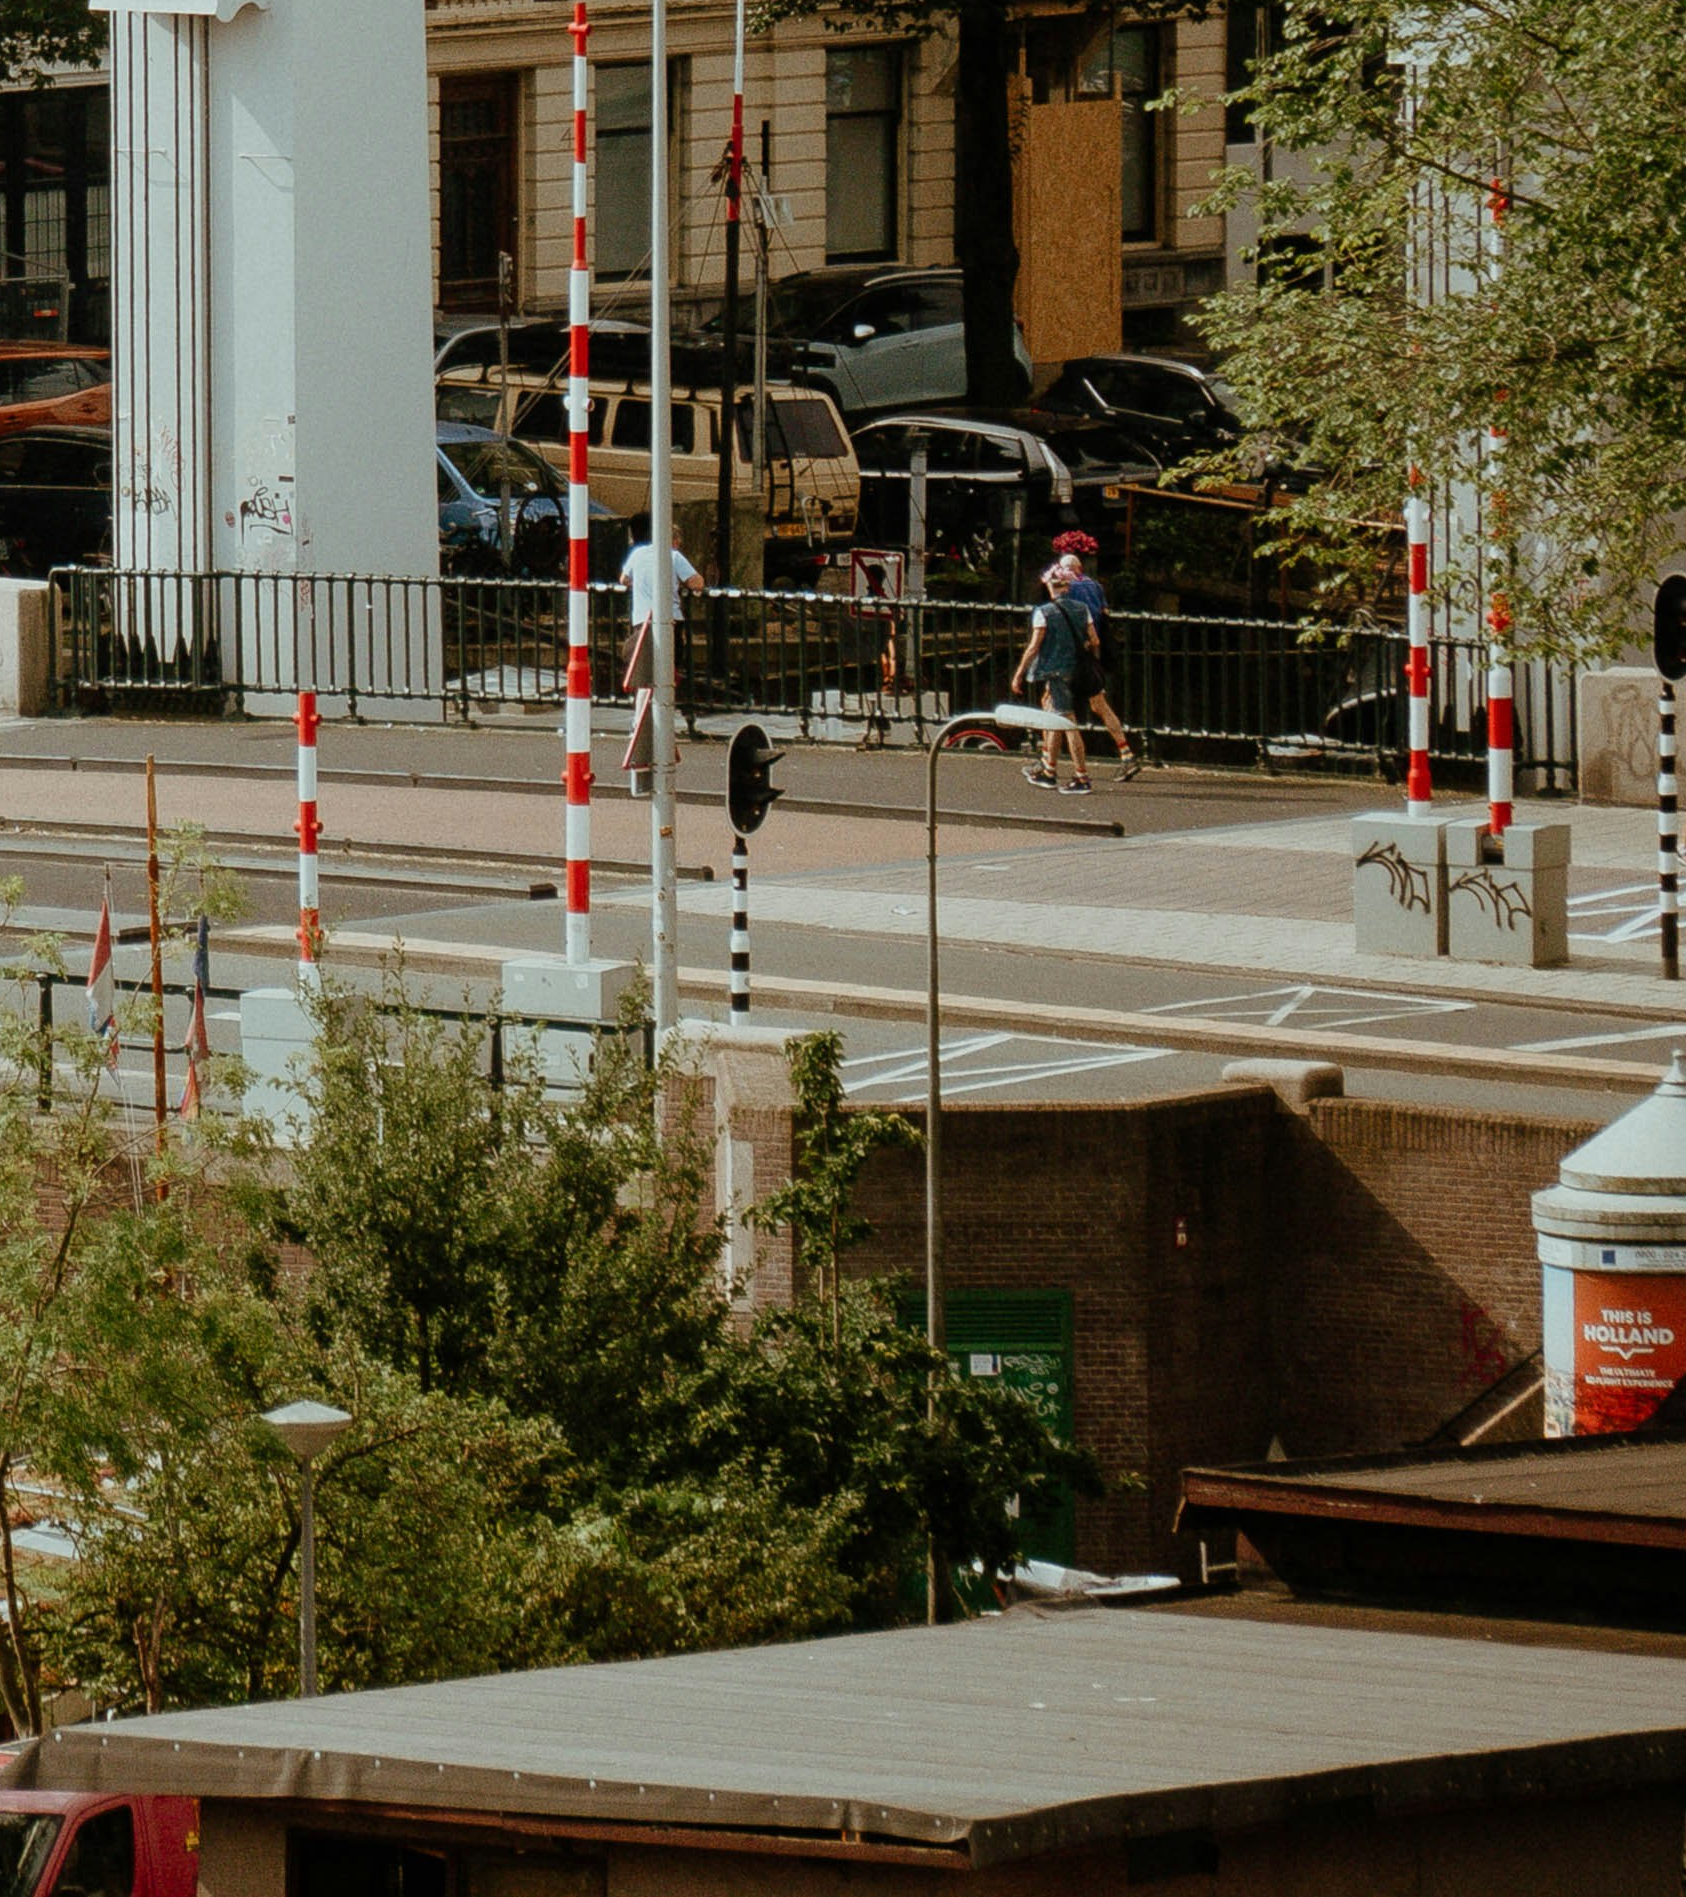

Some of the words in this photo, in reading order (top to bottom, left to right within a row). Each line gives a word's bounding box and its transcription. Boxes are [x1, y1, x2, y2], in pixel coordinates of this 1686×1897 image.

[1600, 1308, 1635, 1324] THIS
[1636, 1310, 1653, 1325] IS
[1583, 1323, 1675, 1345] HOLLAND
